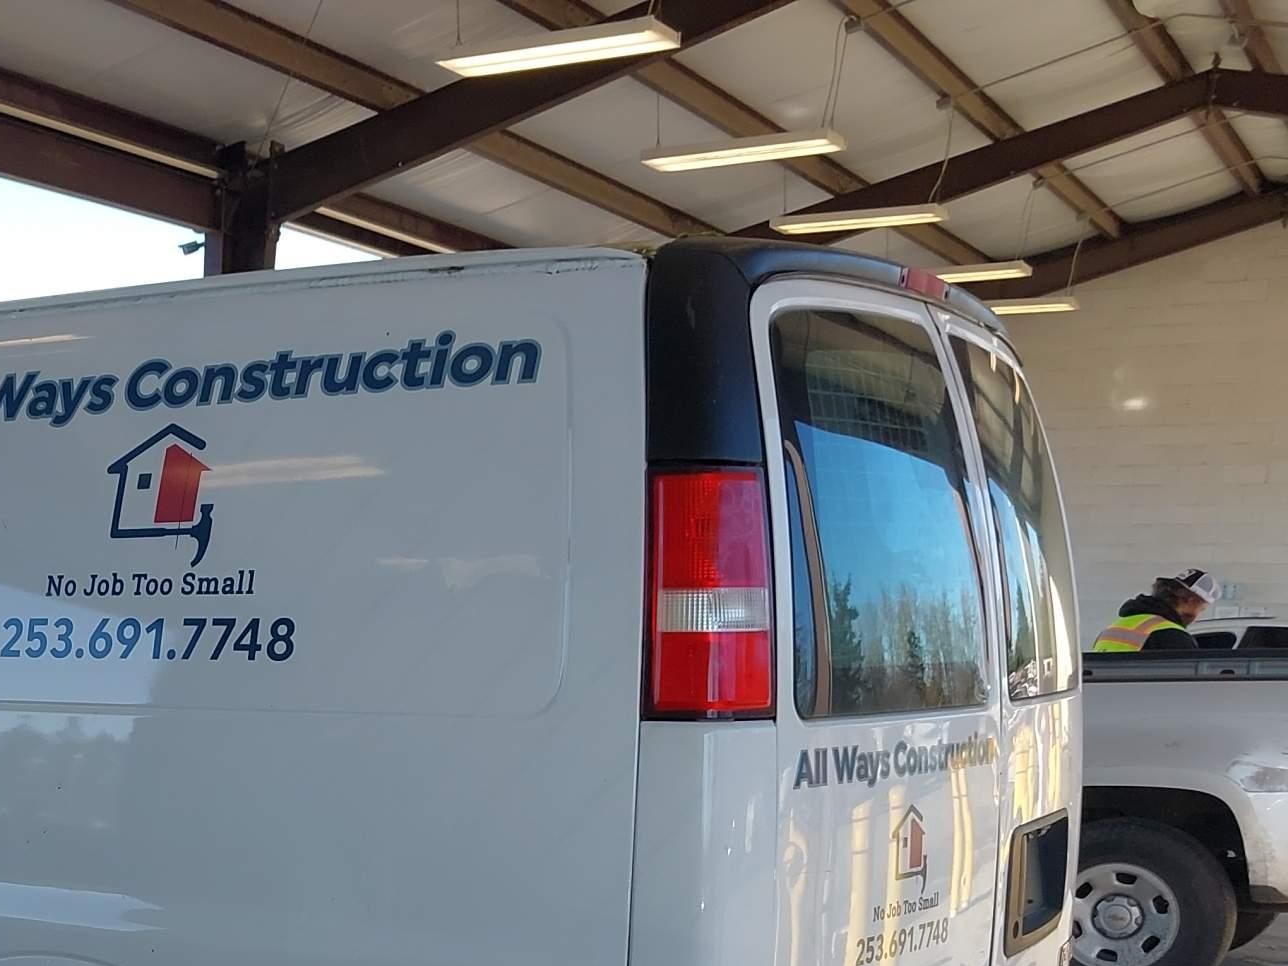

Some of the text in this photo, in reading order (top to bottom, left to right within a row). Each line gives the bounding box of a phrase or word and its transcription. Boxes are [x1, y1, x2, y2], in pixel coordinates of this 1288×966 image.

[124, 329, 542, 411] Construction
[45, 570, 256, 597] No Job Too Small
[0, 616, 297, 662] 253.691.7748
[793, 731, 997, 790] All Ways Construction
[873, 891, 940, 922] No Job Too Small
[855, 917, 949, 966] 253.691.7748
